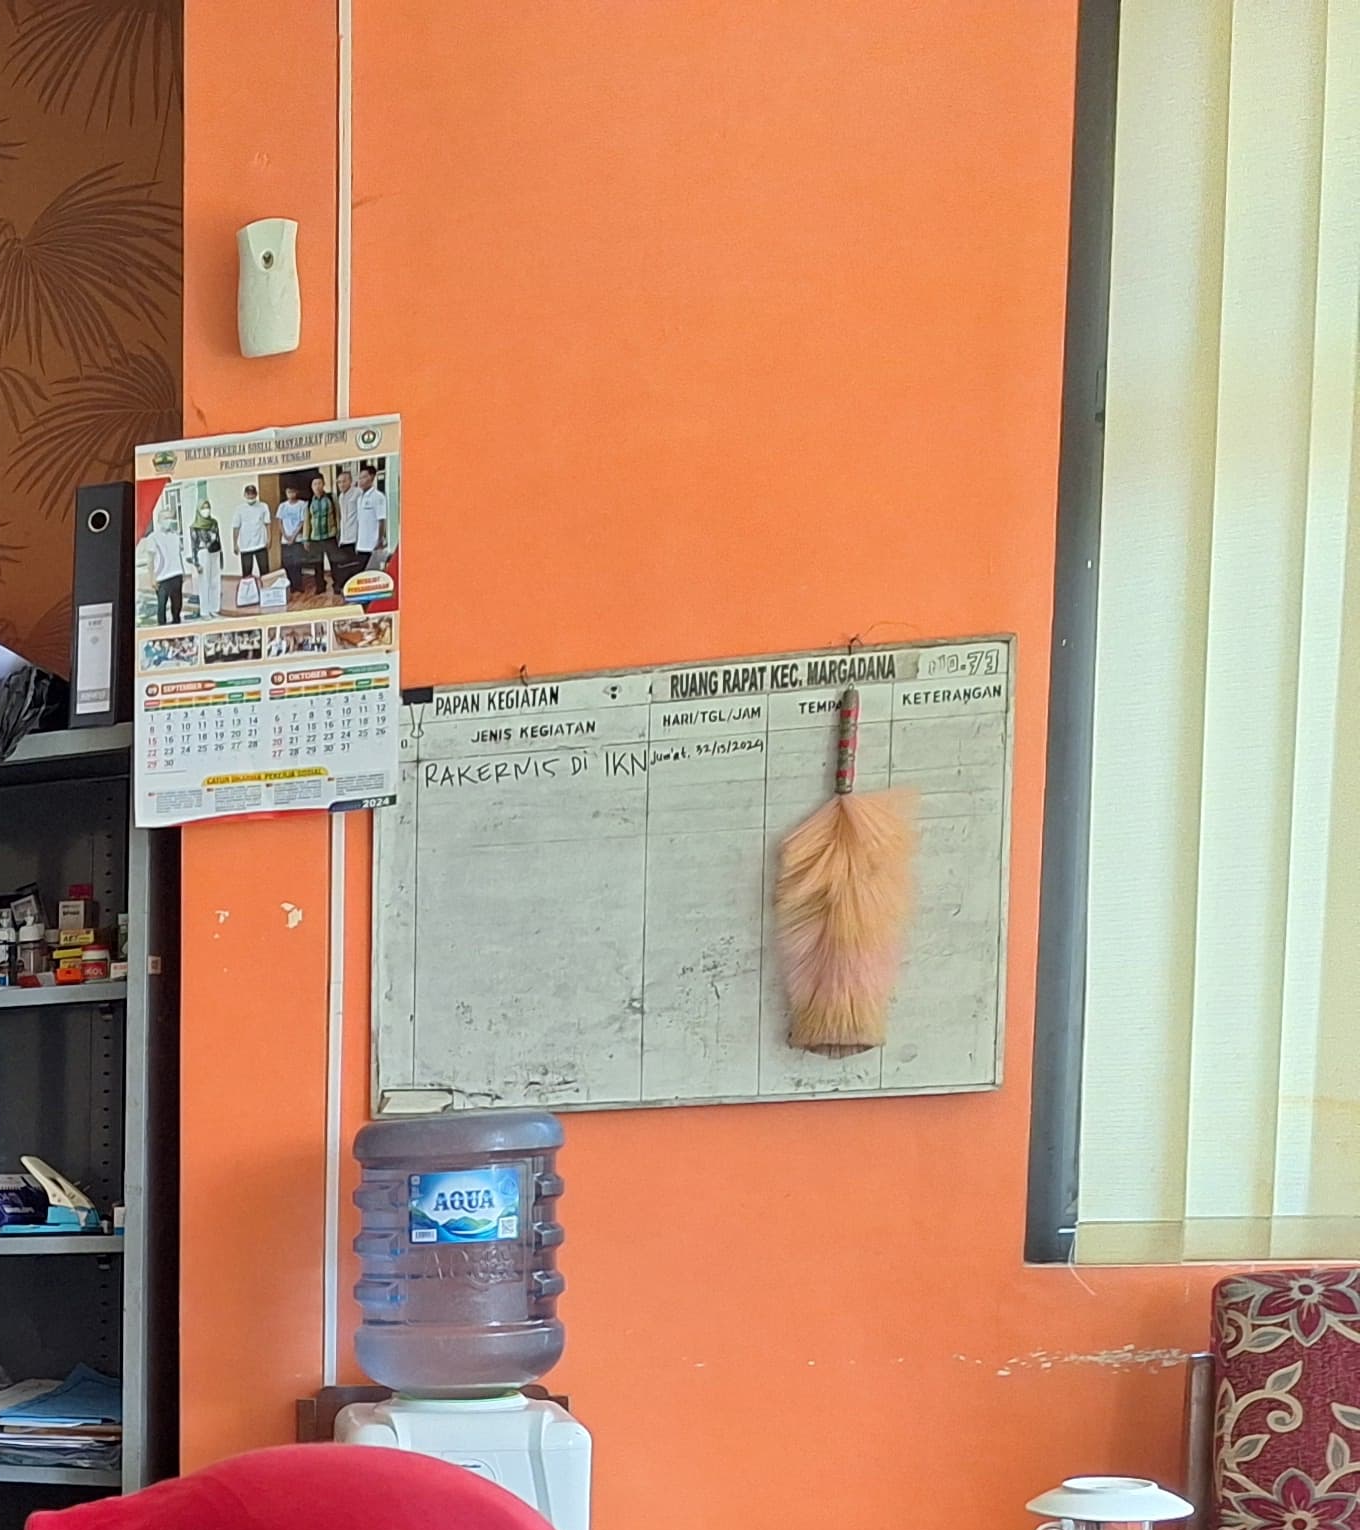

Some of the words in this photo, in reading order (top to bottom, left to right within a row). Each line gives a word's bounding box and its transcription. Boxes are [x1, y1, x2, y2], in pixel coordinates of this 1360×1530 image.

[288, 670, 328, 681] OKTOBER
[670, 671, 719, 699] RUANG
[721, 666, 766, 694] RAPAT
[770, 660, 803, 690] KEC.
[807, 654, 896, 686] MARGADANA
[435, 693, 480, 716] PAPAN
[487, 686, 559, 711] KEGIATAN
[902, 685, 1002, 706] KETERANGAN
[663, 706, 761, 728] HARI/TGL/JAM
[799, 700, 842, 715] TEMPA
[471, 727, 512, 743] JENIS
[519, 721, 596, 739] KEGIATAN
[605, 750, 647, 777] IKN
[362, 797, 390, 808] 2024
[433, 1189, 495, 1213] AQUA
